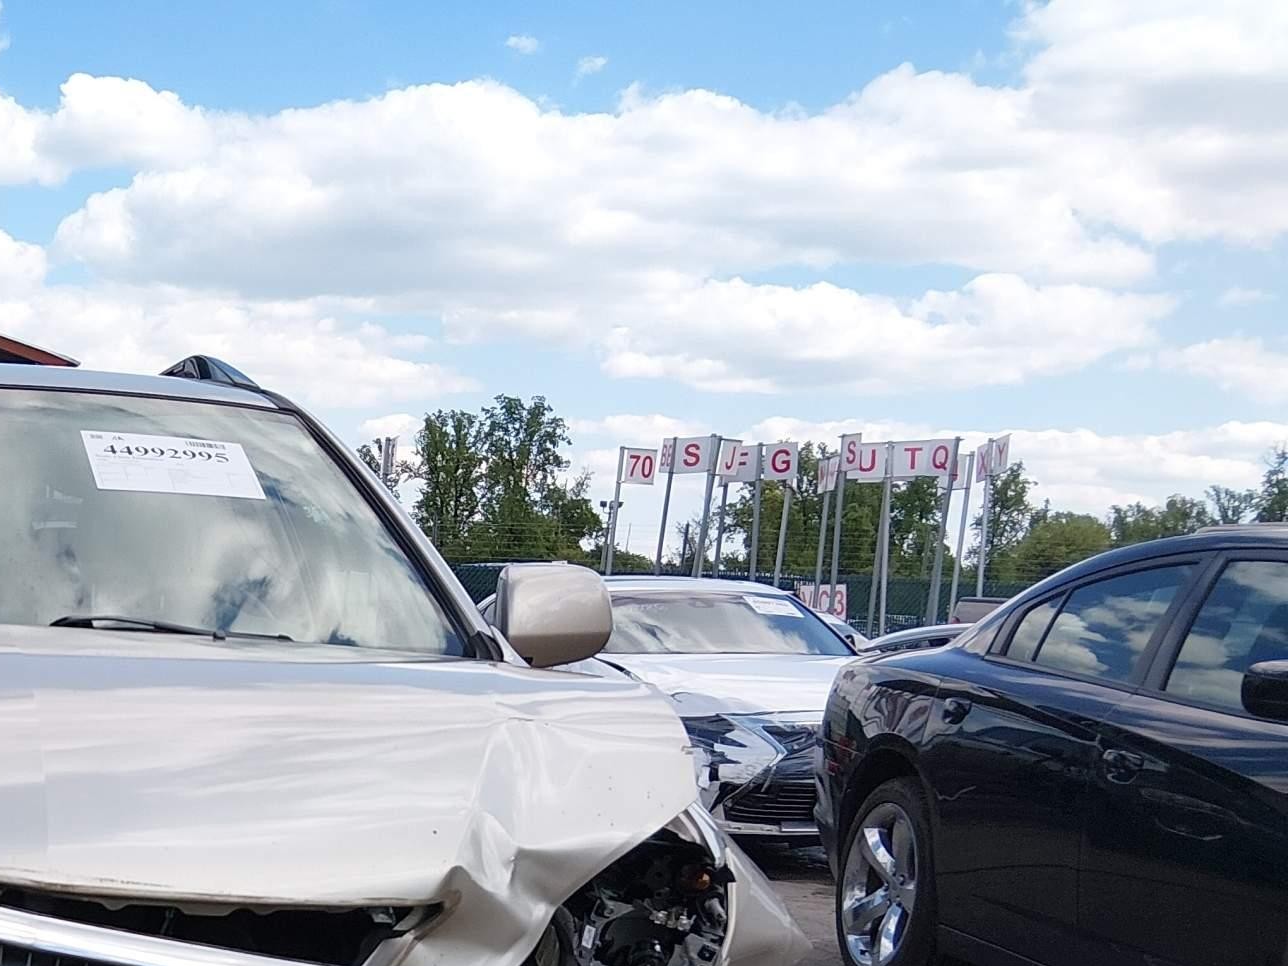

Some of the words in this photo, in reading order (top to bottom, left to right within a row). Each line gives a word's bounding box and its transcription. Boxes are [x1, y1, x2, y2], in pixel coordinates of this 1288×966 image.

[103, 444, 230, 464] 44992995
[683, 443, 701, 467] S
[725, 446, 736, 470] J
[771, 449, 791, 473] G
[846, 440, 856, 464] S
[859, 449, 876, 472] U
[904, 447, 923, 470] T
[932, 445, 948, 471] Q
[629, 455, 653, 478] 70
